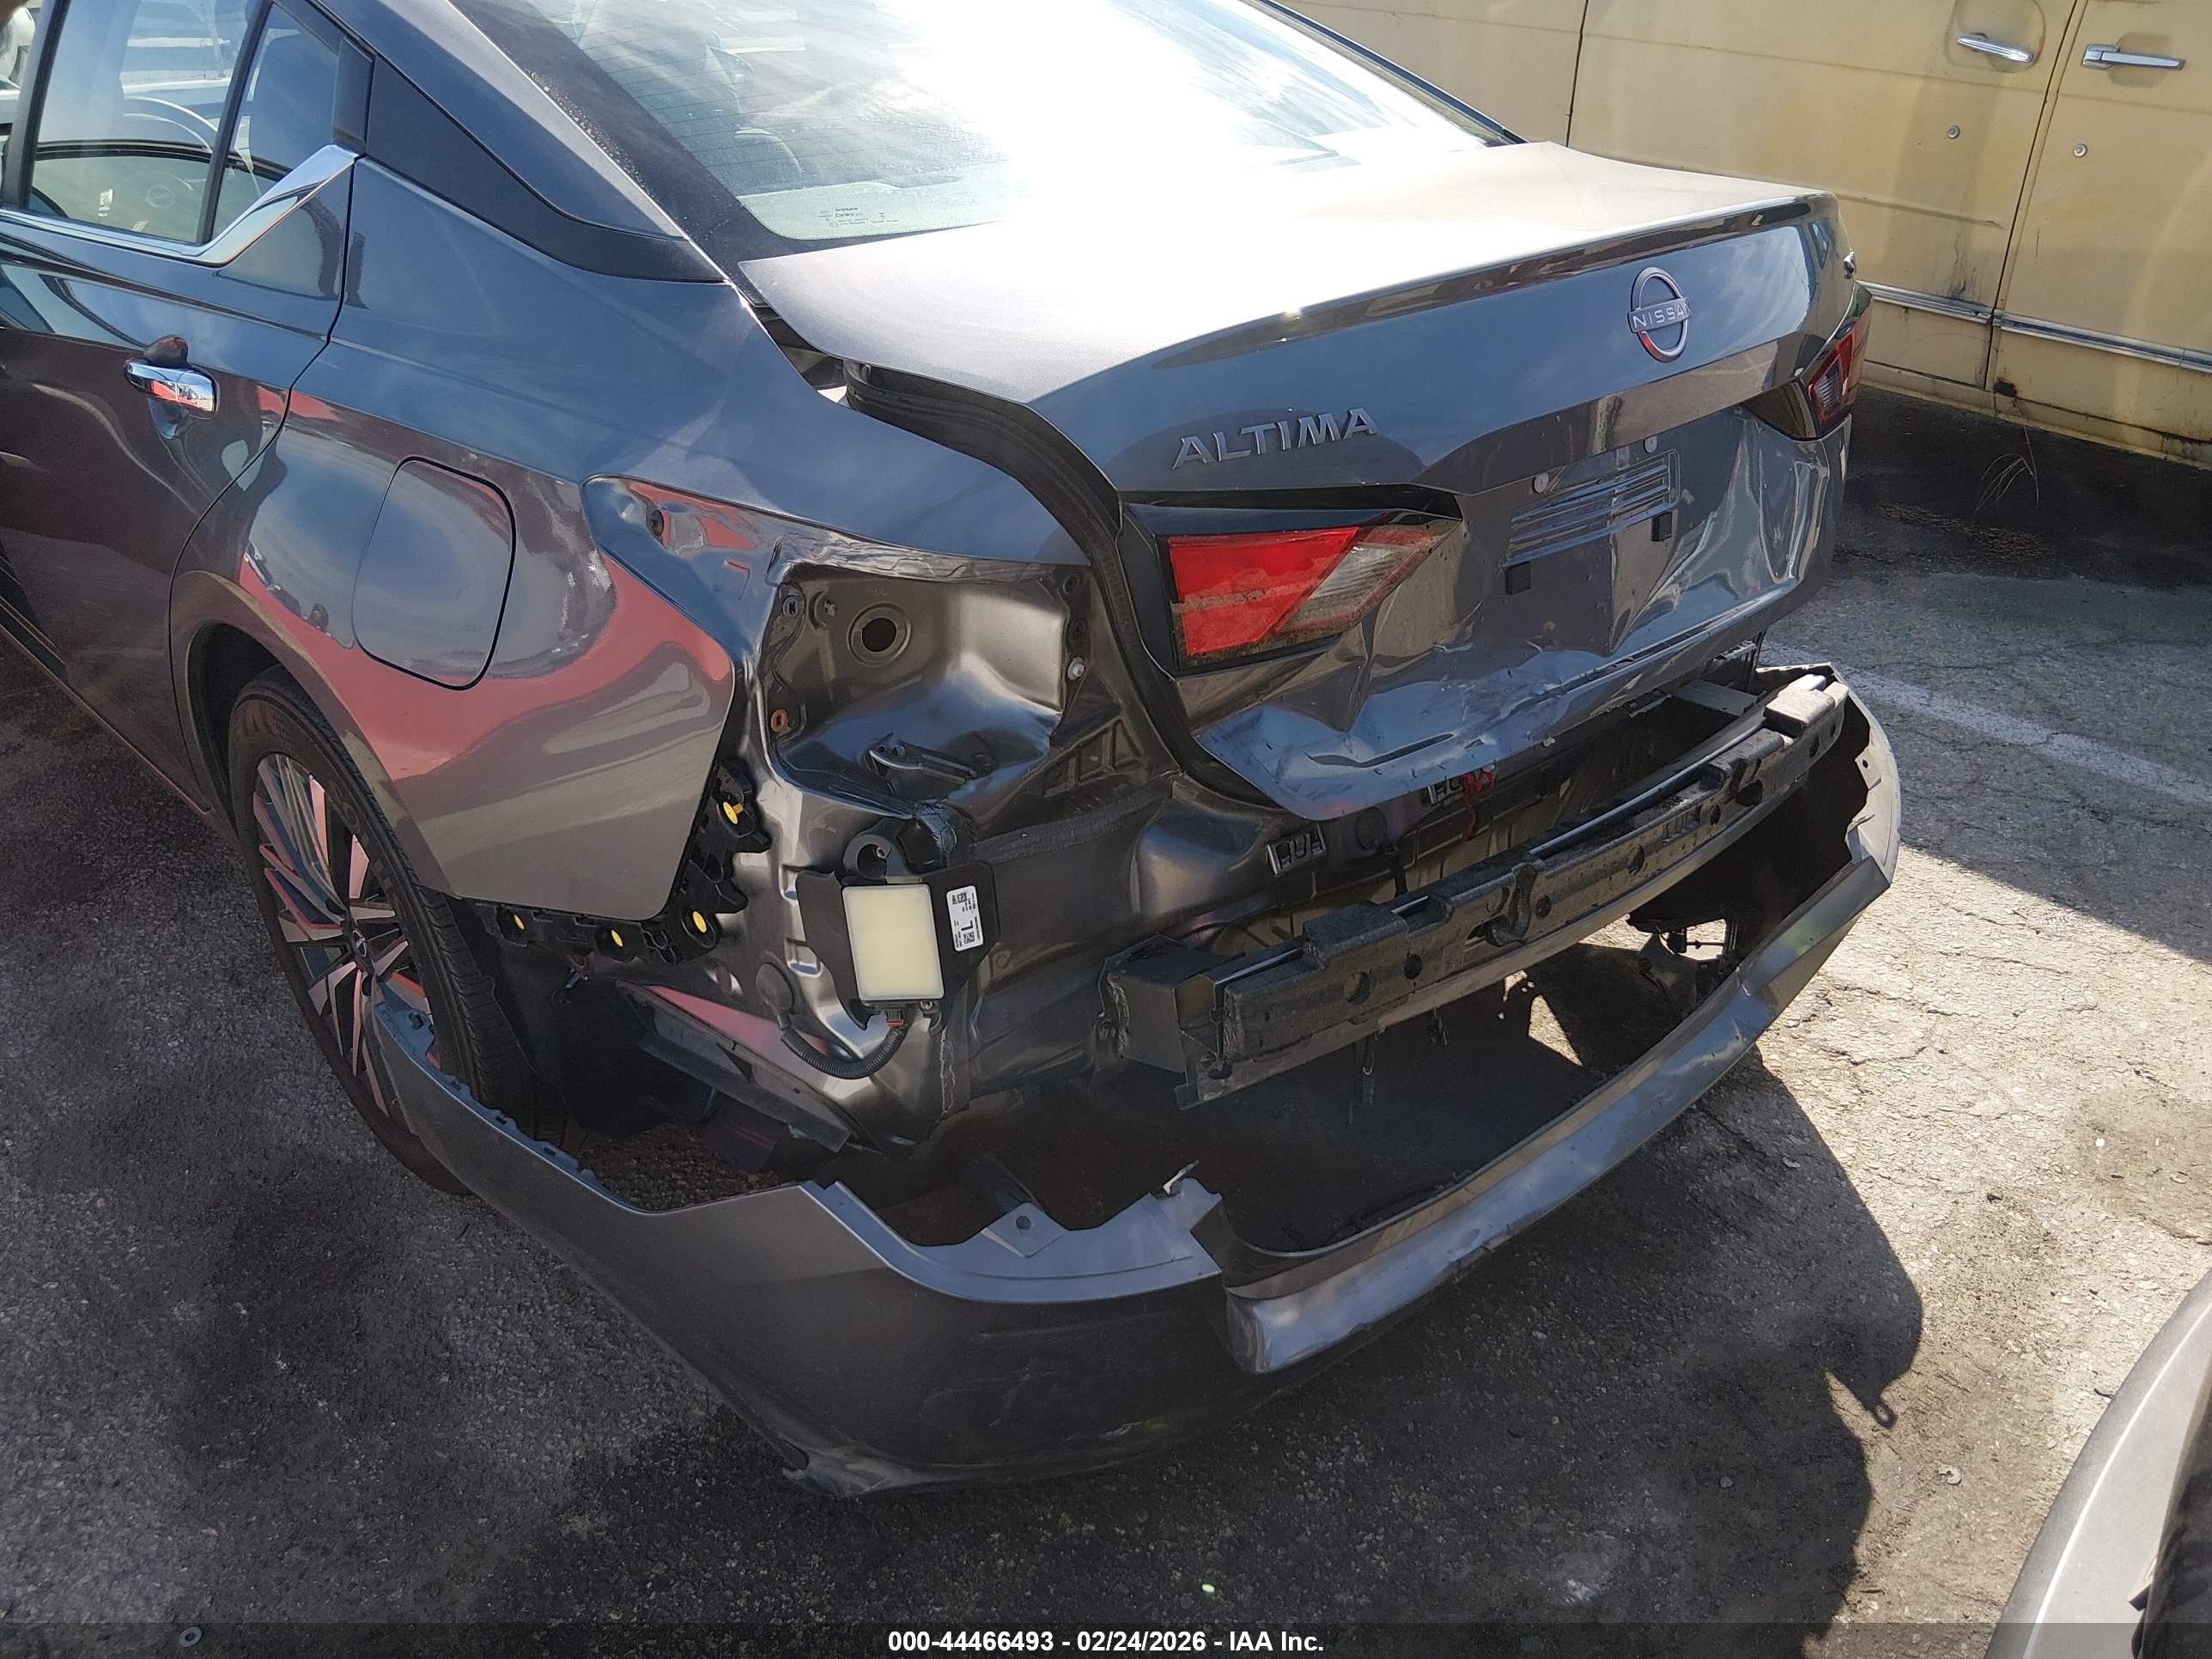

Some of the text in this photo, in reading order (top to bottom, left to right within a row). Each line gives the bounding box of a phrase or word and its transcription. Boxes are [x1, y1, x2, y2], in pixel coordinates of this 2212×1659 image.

[1632, 301, 1691, 329] NISSAN
[1171, 408, 1377, 470] ALTIMA
[961, 920, 973, 931] L
